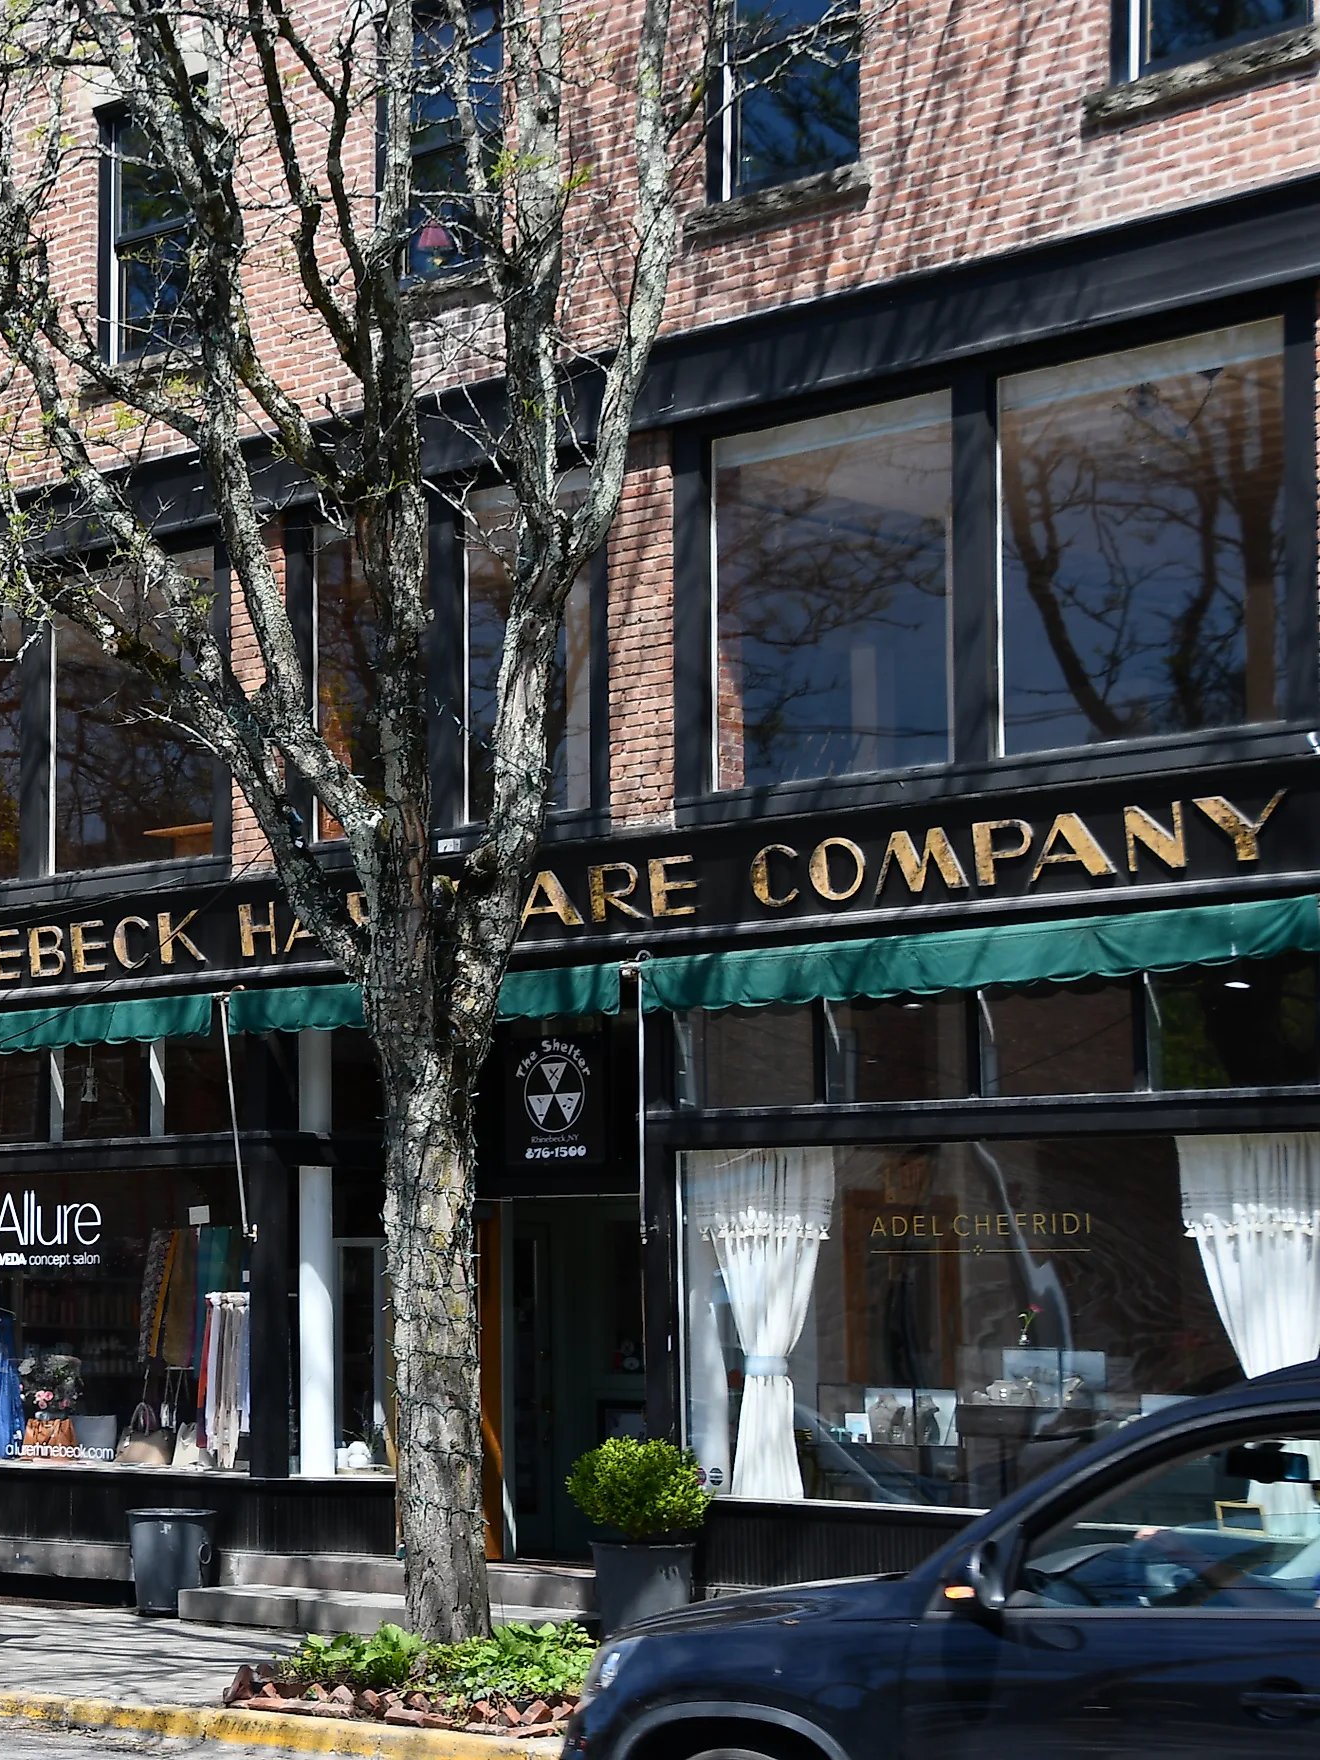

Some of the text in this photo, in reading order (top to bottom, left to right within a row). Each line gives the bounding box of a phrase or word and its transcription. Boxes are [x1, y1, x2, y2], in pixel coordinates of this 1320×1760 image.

[238, 854, 699, 958] HARE
[749, 788, 1288, 908] COMPANY
[516, 1039, 591, 1079] The Shelter
[870, 1211, 1092, 1238] ADEL CHEFRIDI
[28, 1253, 71, 1269] concept
[72, 1251, 101, 1265] salon
